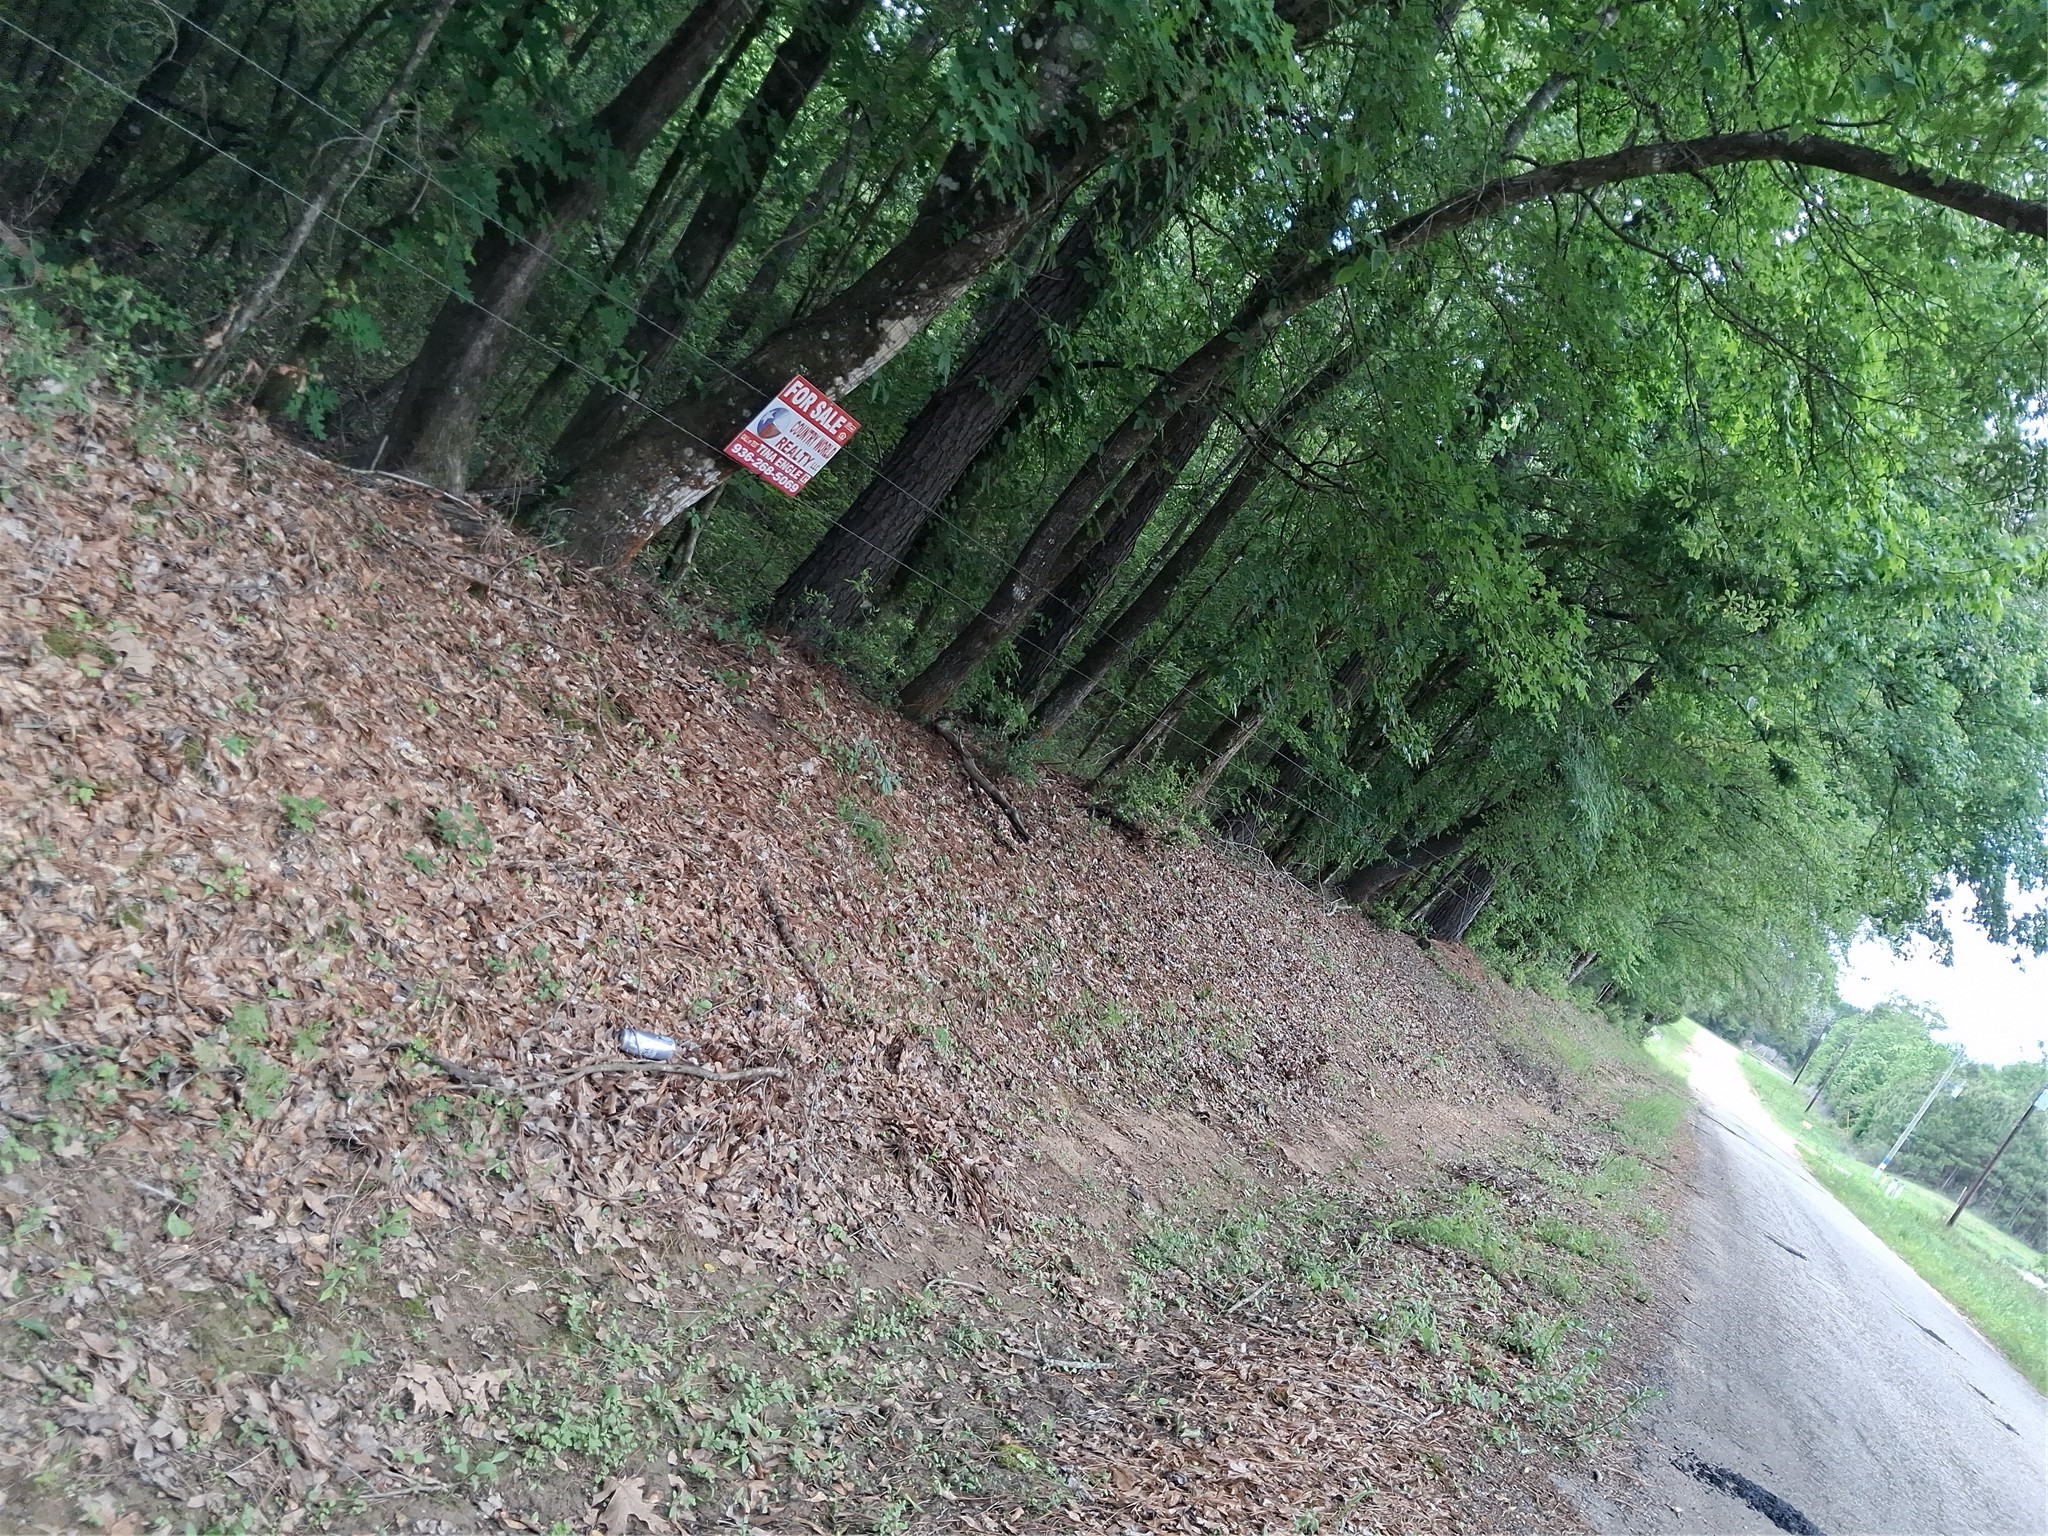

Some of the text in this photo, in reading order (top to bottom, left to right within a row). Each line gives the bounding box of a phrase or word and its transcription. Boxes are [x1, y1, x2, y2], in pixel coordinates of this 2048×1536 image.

[784, 380, 847, 434] FOR SALE
[775, 437, 815, 466] REALTY
[789, 421, 821, 447] COUNTRY
[813, 439, 838, 459] WORLD
[731, 443, 799, 492] 936-268-5069
[756, 444, 777, 462] TINA
[774, 457, 803, 479] ENGLE
